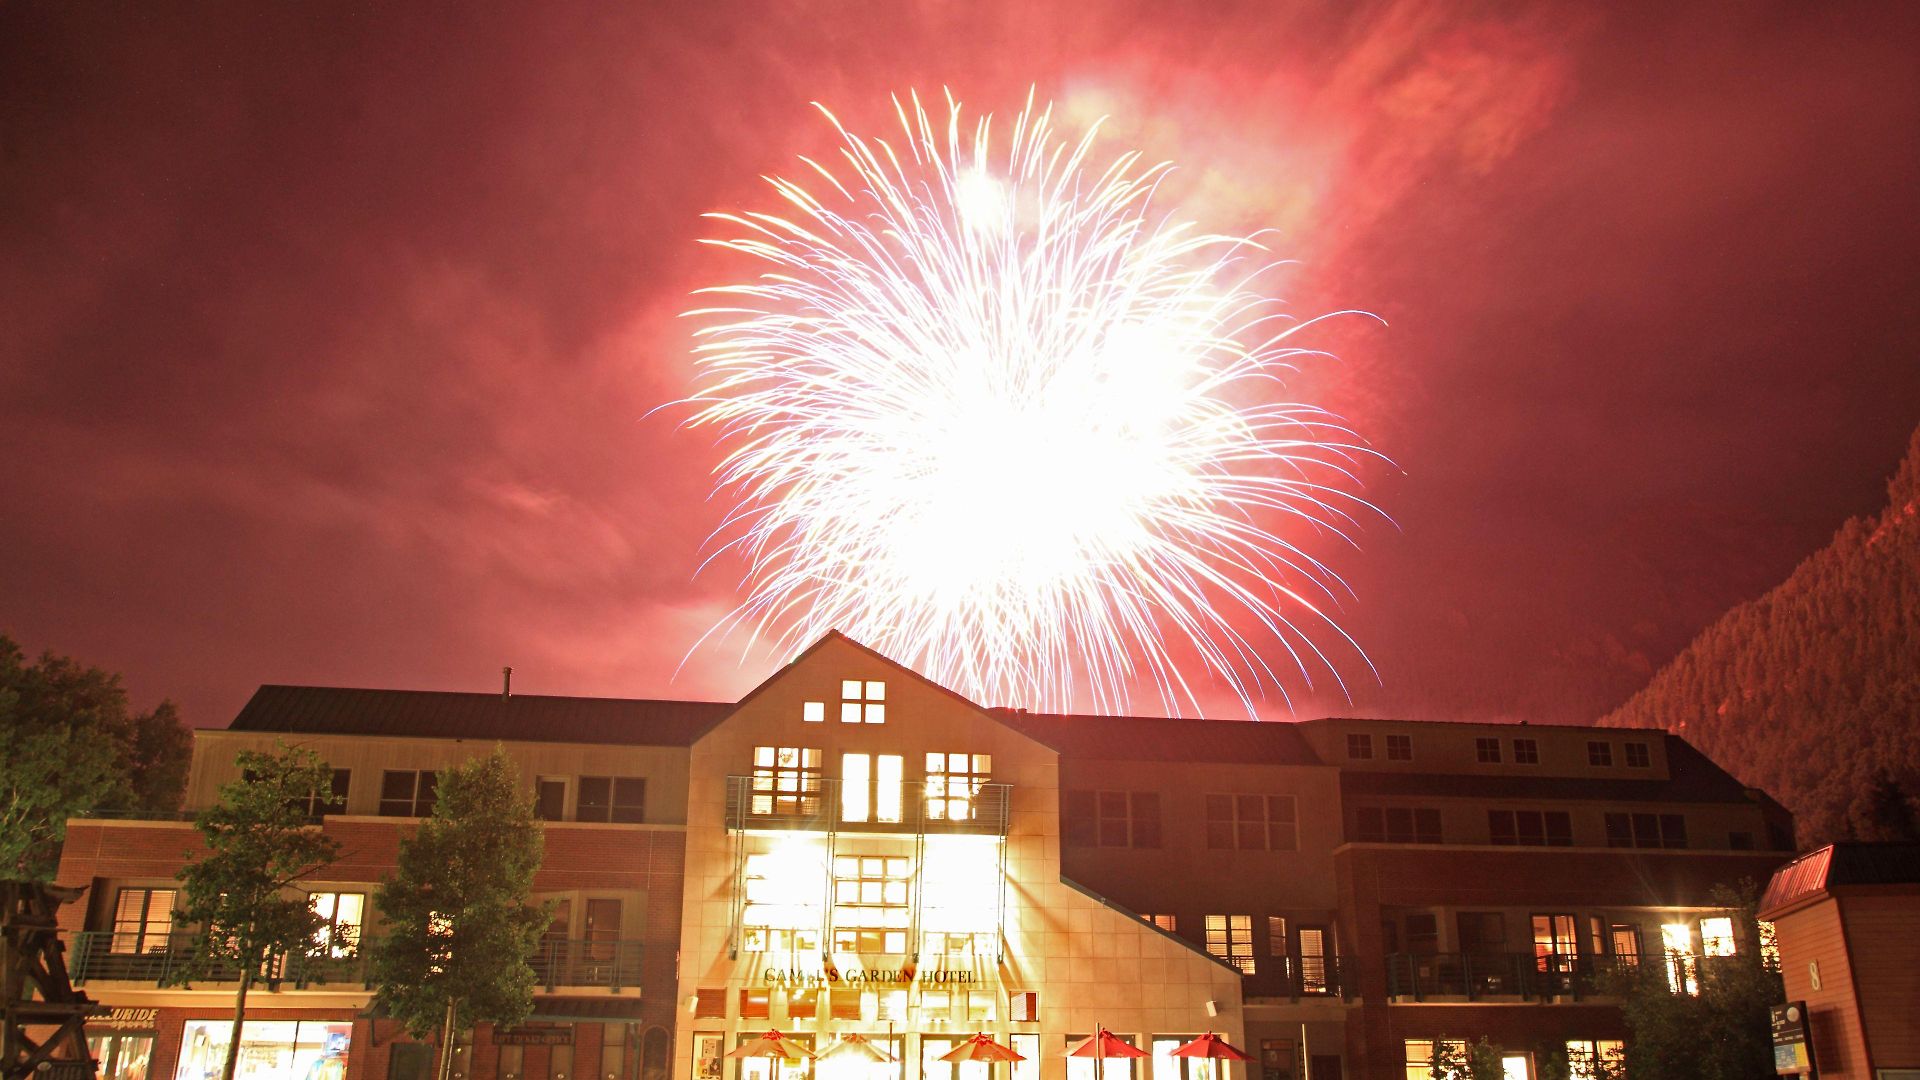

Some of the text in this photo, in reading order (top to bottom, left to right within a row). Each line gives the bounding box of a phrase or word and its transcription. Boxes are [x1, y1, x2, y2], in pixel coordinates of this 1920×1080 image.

[764, 967, 976, 984] CAML'S GARDEN HOTEL
[1809, 962, 1819, 990] 8
